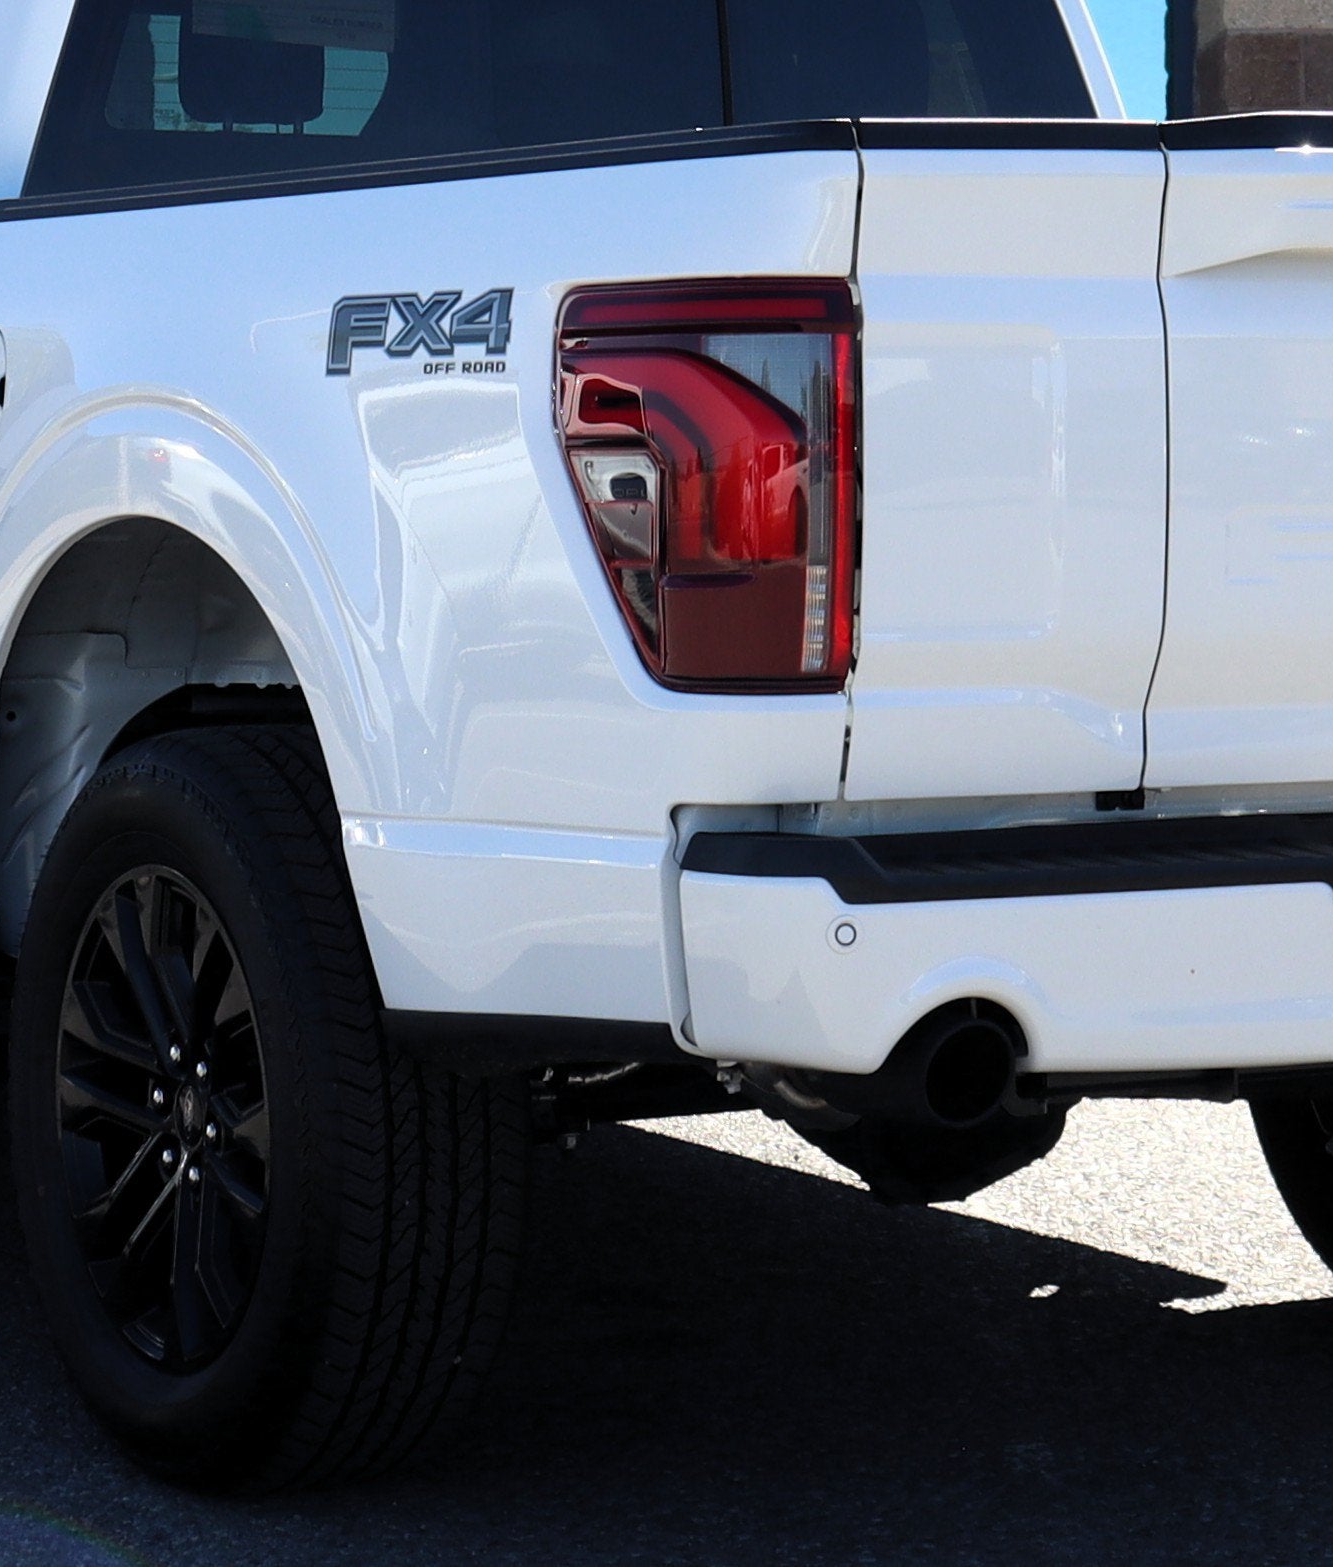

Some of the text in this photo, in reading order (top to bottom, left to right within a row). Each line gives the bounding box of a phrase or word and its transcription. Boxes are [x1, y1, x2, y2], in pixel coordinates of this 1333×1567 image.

[326, 287, 515, 376] FX4
[423, 361, 506, 375] OFF ROAD
